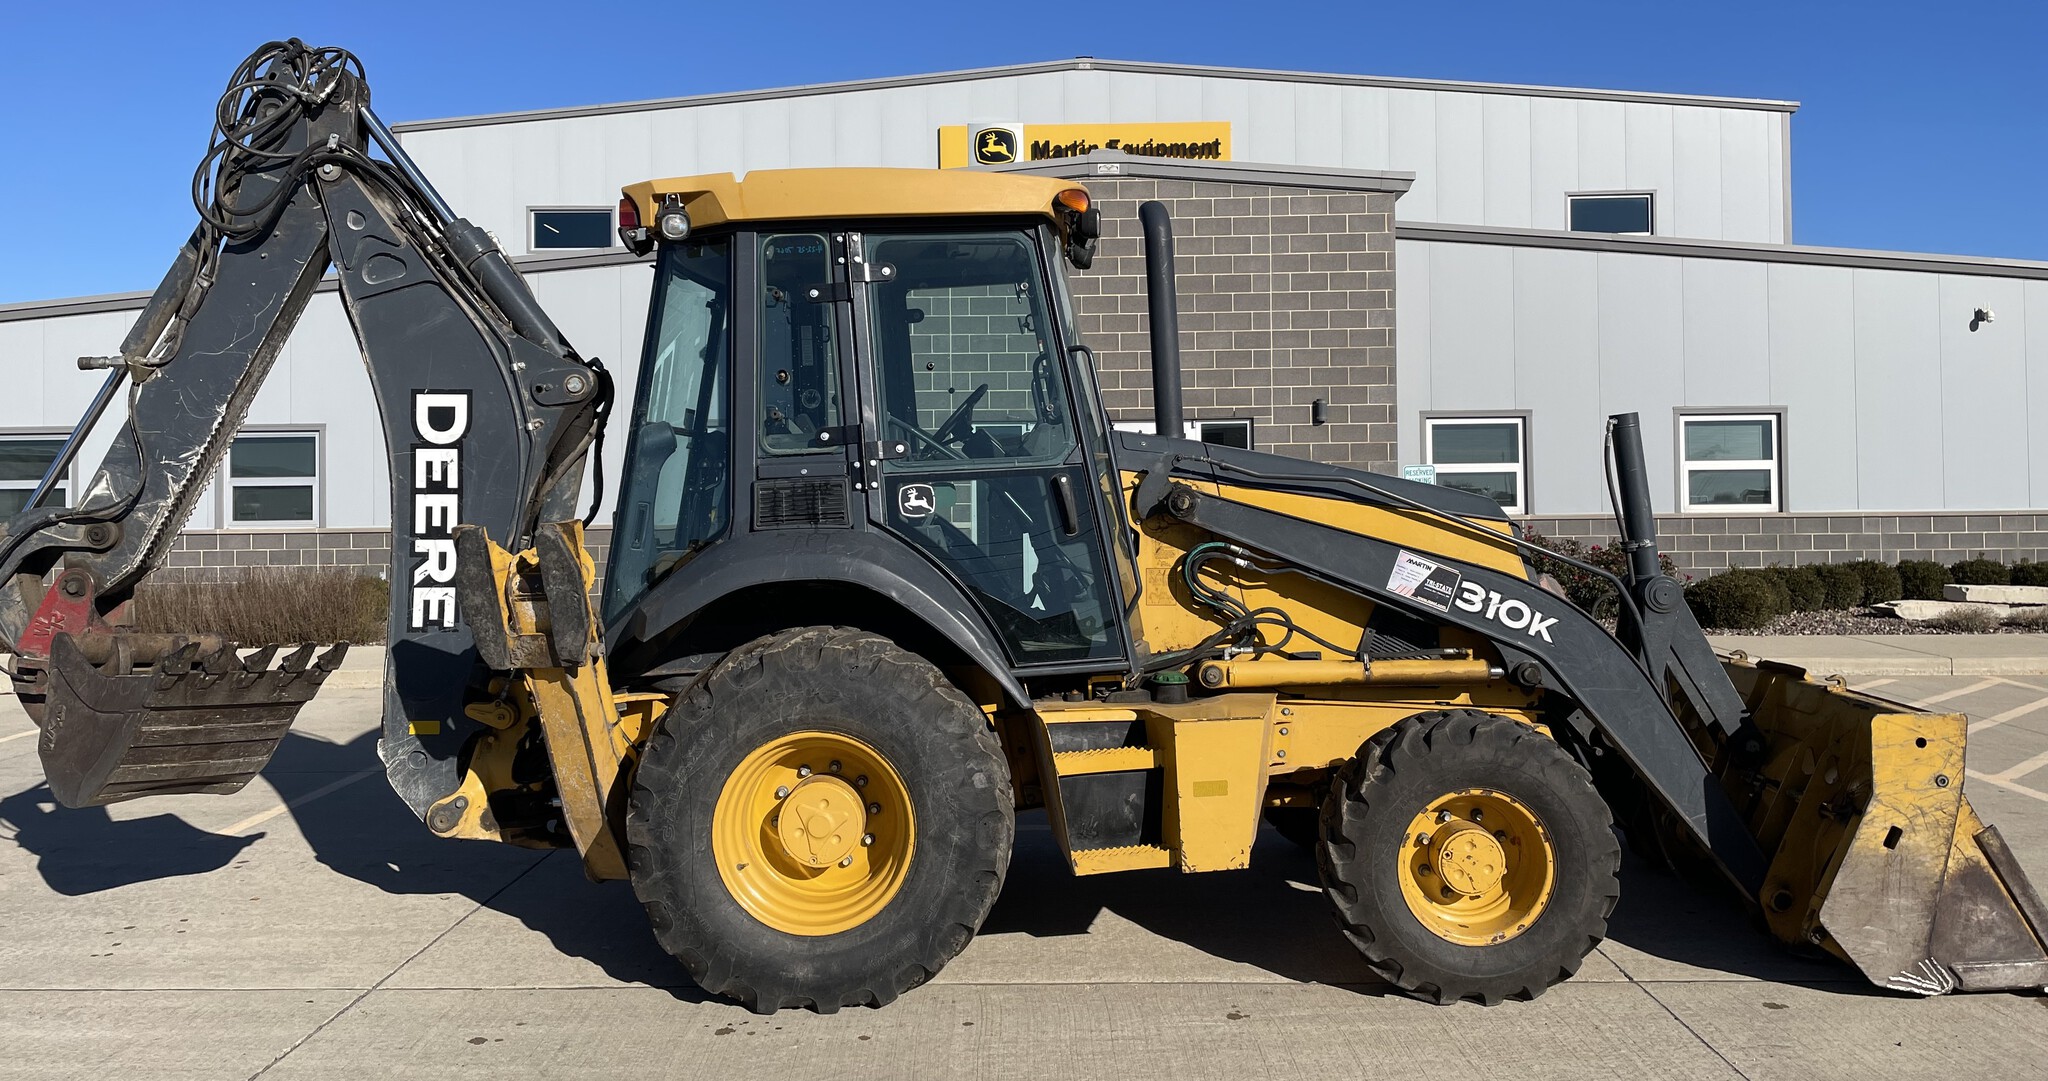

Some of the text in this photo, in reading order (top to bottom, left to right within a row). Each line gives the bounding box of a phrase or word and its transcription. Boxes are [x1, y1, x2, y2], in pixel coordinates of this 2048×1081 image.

[411, 393, 468, 628] DEERE
[1406, 557, 1433, 571] MARTIN
[1455, 580, 1559, 644] 310K
